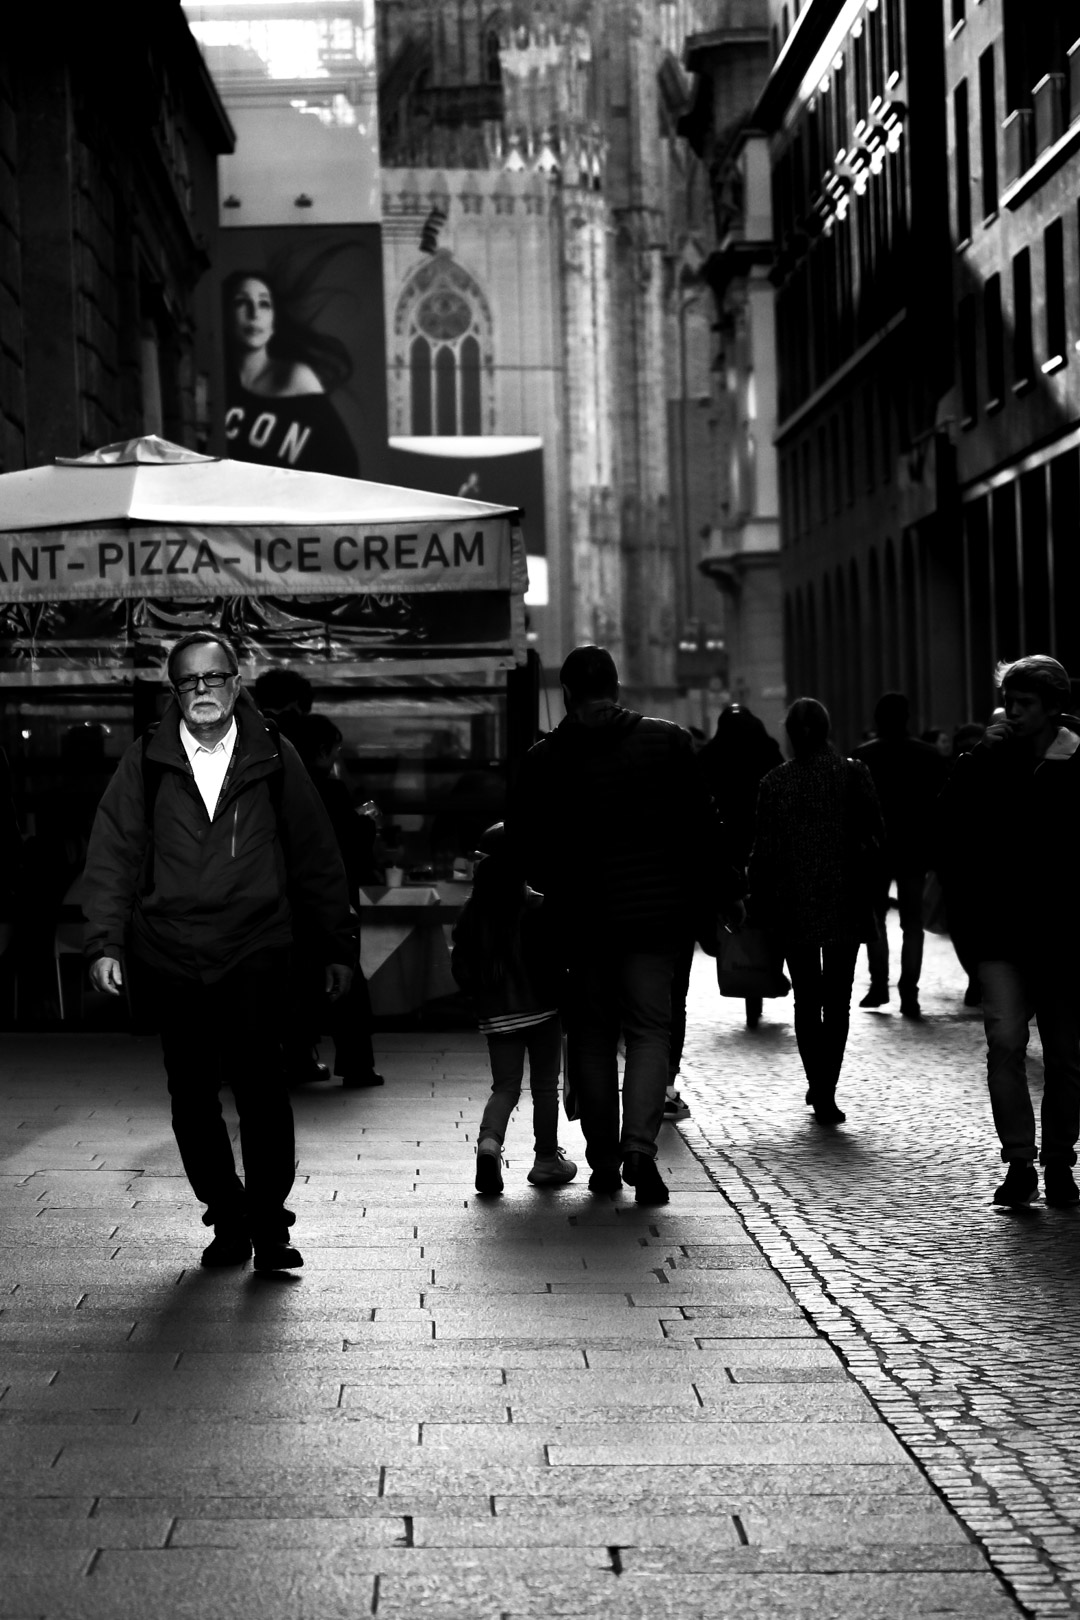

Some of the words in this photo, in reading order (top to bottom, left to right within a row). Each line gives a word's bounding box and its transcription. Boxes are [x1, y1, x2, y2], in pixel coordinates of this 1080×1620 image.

[225, 406, 312, 465] CON
[0, 544, 84, 582] NT-
[255, 537, 322, 573] ICE
[333, 531, 485, 571] CREAM
